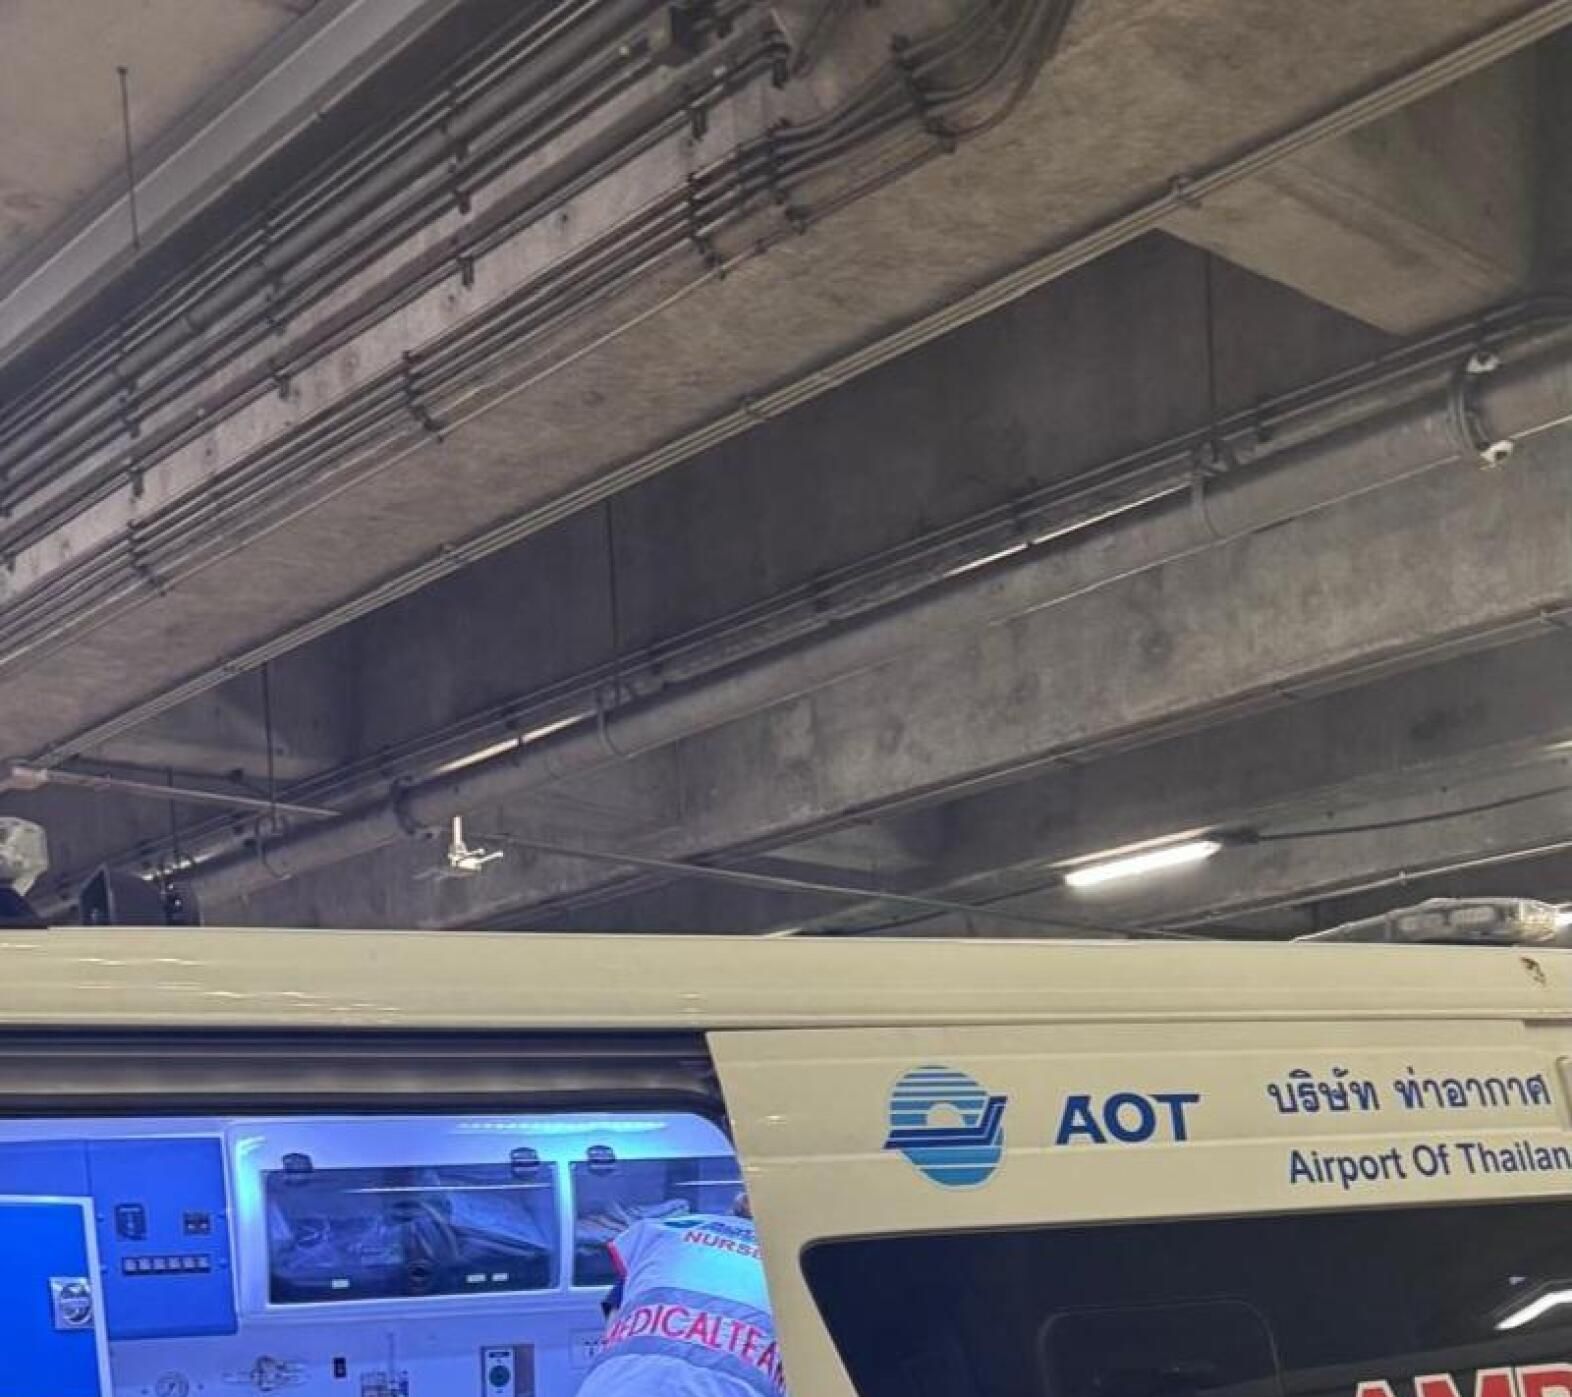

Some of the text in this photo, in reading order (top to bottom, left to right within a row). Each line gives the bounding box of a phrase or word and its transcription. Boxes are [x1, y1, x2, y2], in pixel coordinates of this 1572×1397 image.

[1267, 1066, 1552, 1113] บริษัท ท่าอากาศ
[1056, 1092, 1200, 1146] AOT
[1290, 1147, 1407, 1190] Airport
[1412, 1143, 1450, 1177] Of
